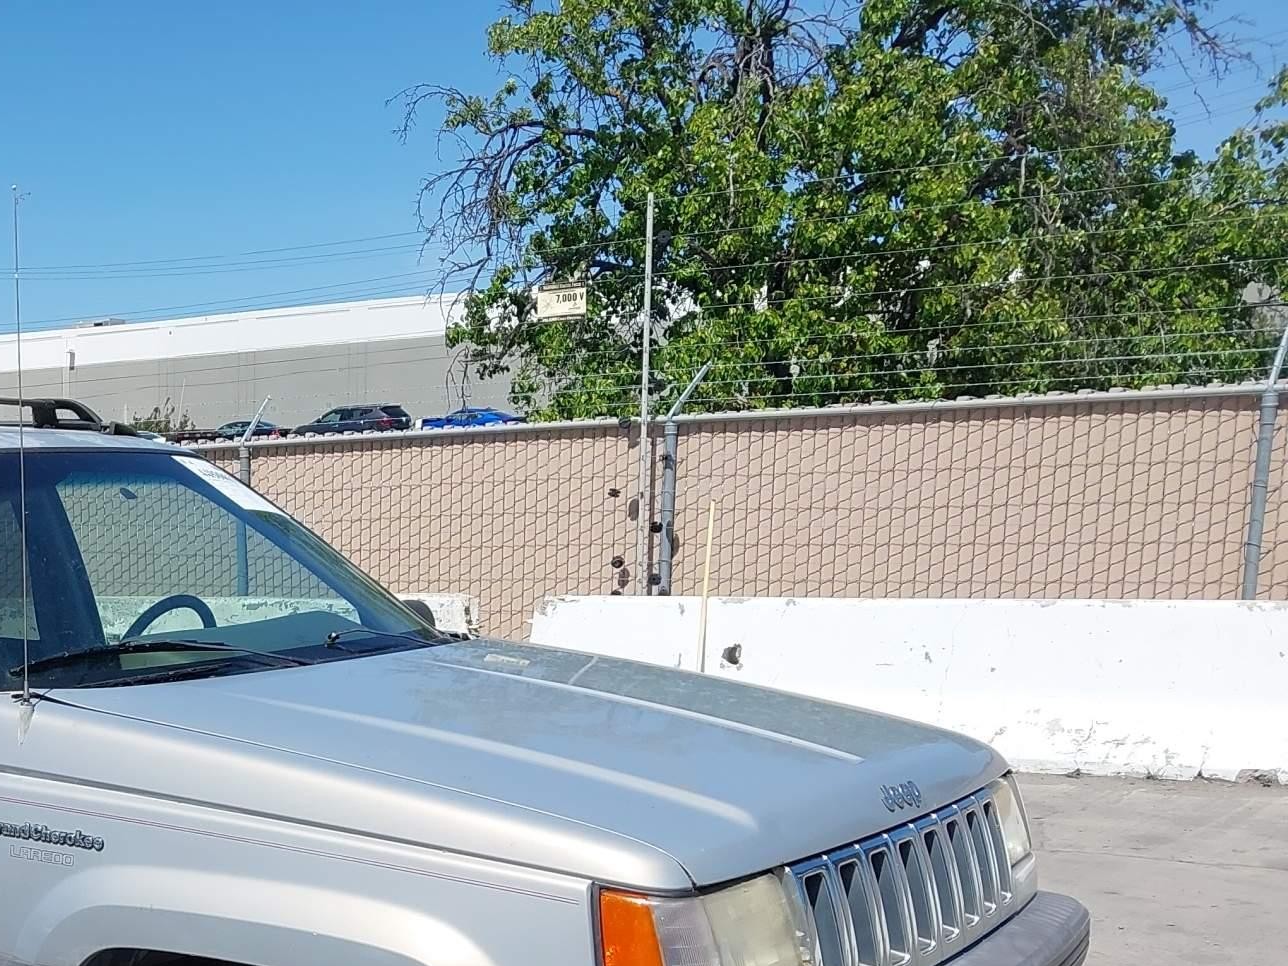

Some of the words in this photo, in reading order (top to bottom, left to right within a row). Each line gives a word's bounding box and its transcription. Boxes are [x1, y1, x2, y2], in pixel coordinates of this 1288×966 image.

[555, 292, 578, 304] 7,000
[579, 291, 585, 301] V
[879, 780, 922, 812] Jeep
[9, 844, 75, 867] LAREDO
